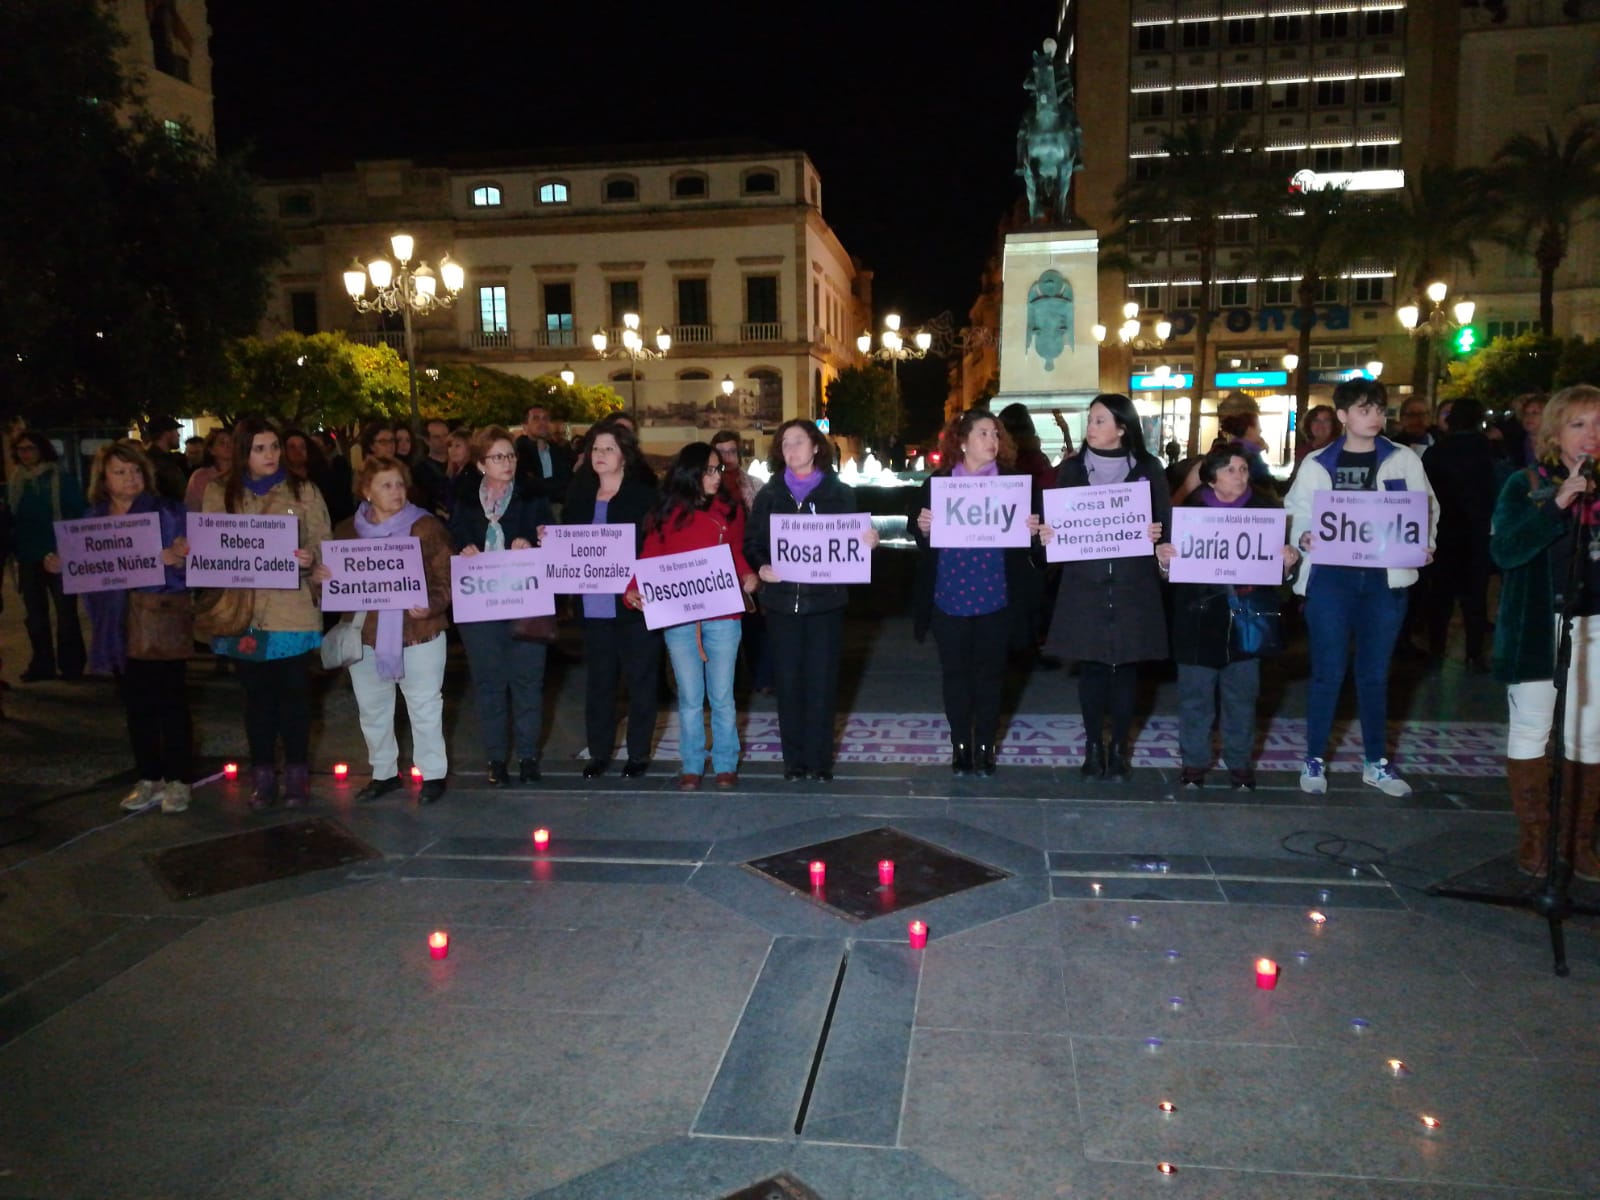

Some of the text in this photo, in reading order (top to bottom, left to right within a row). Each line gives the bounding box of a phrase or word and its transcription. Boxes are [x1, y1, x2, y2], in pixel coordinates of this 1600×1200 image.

[948, 481, 957, 489] de
[990, 480, 1024, 490] Taagona
[945, 496, 1017, 533] Kelly
[1052, 511, 1146, 530] Concepción
[69, 524, 79, 534] de
[81, 523, 101, 533] enero
[103, 521, 113, 530] en
[205, 518, 214, 528] de
[215, 519, 237, 529] enero
[239, 519, 248, 529] en
[250, 518, 286, 530] Cantabria
[791, 519, 801, 531] de
[802, 521, 824, 532] enero
[825, 520, 835, 530] en
[836, 518, 861, 531] Sevilla
[1319, 511, 1420, 550] Sheyla
[220, 533, 265, 549] Rebeca
[555, 527, 623, 539] 12 de enero en Málaga
[1057, 529, 1142, 545] Hernández
[85, 534, 133, 552] Romina
[330, 542, 415, 554] 17 de enero en Zaragoza
[570, 543, 607, 558] Leonor
[777, 538, 865, 563] Rosa R.R.
[1095, 545, 1120, 554] años)
[1181, 531, 1274, 561] Daría O.L.
[68, 555, 158, 577] Celeste Núñez
[190, 554, 296, 573] Alexandra Cadete
[344, 556, 404, 572] Rebeca
[546, 562, 581, 578] Muñoz
[583, 562, 631, 578] González
[329, 576, 421, 595] Santamalia
[460, 575, 539, 596] Stean
[642, 568, 735, 604] Desconocida
